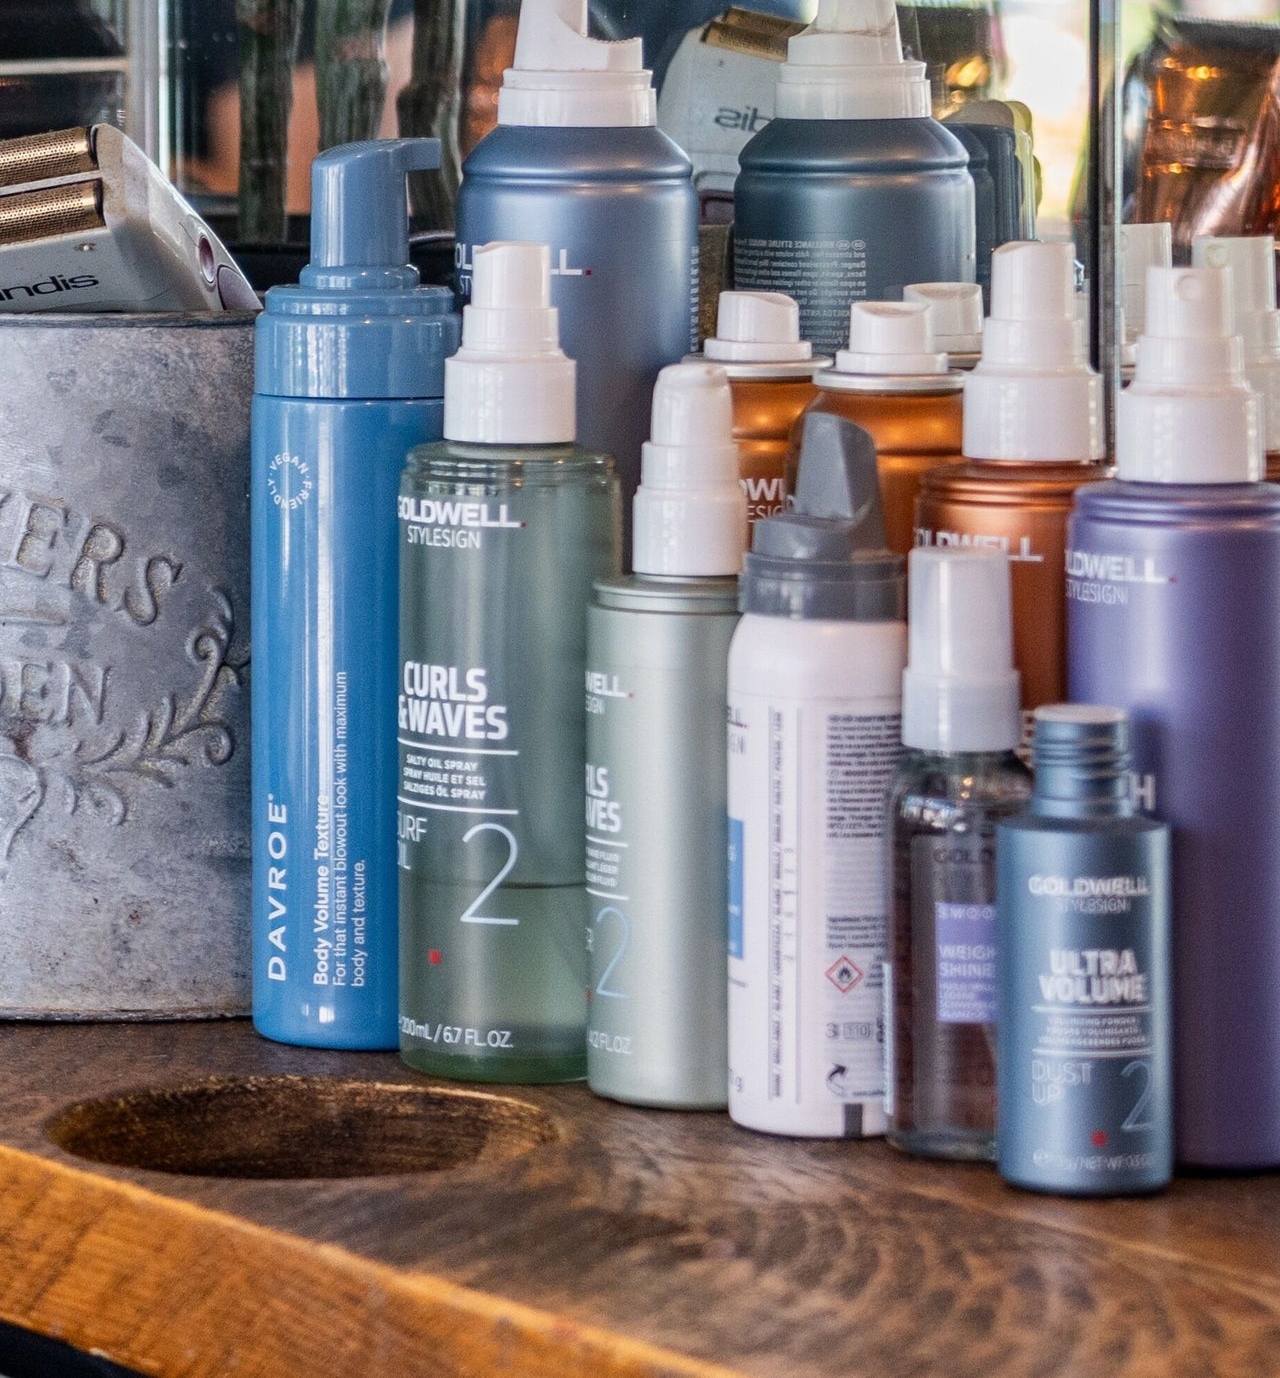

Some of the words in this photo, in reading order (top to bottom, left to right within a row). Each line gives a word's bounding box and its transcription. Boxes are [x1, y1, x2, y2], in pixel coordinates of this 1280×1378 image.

[269, 452, 309, 475] VEGAN
[267, 478, 312, 510] FRIENDLY
[407, 525, 481, 549] STYLESIGN
[404, 660, 488, 703] CURLS
[334, 671, 348, 739] maximum
[334, 743, 348, 774] with
[406, 753, 426, 767] SALTY
[427, 757, 443, 769] OIL
[444, 759, 479, 772] SPRAY
[403, 767, 422, 779] SPRAY
[423, 770, 449, 783] HUILE
[450, 773, 464, 785] ET
[465, 775, 486, 787] SEL
[403, 780, 435, 796] SALZIGES
[450, 788, 486, 800] SPRAY
[333, 777, 348, 809] look
[314, 794, 330, 860] Texture
[333, 814, 348, 871] blowout
[352, 859, 366, 913] texture.
[460, 823, 519, 926] 2
[1028, 876, 1150, 896] GOLDWELL
[313, 865, 330, 933] Volume
[333, 875, 347, 923] instant
[938, 906, 995, 920] SMOO
[333, 928, 347, 957] that
[352, 917, 366, 945] and
[313, 937, 333, 986] Body
[596, 906, 631, 999] 2
[939, 944, 995, 960] WEIGH
[1050, 948, 1138, 975] ULTRA
[333, 961, 347, 986] For
[351, 949, 368, 987] body
[1039, 973, 1146, 1003] VOLUME
[1032, 1060, 1095, 1085] DUST
[1032, 1082, 1066, 1107] UP
